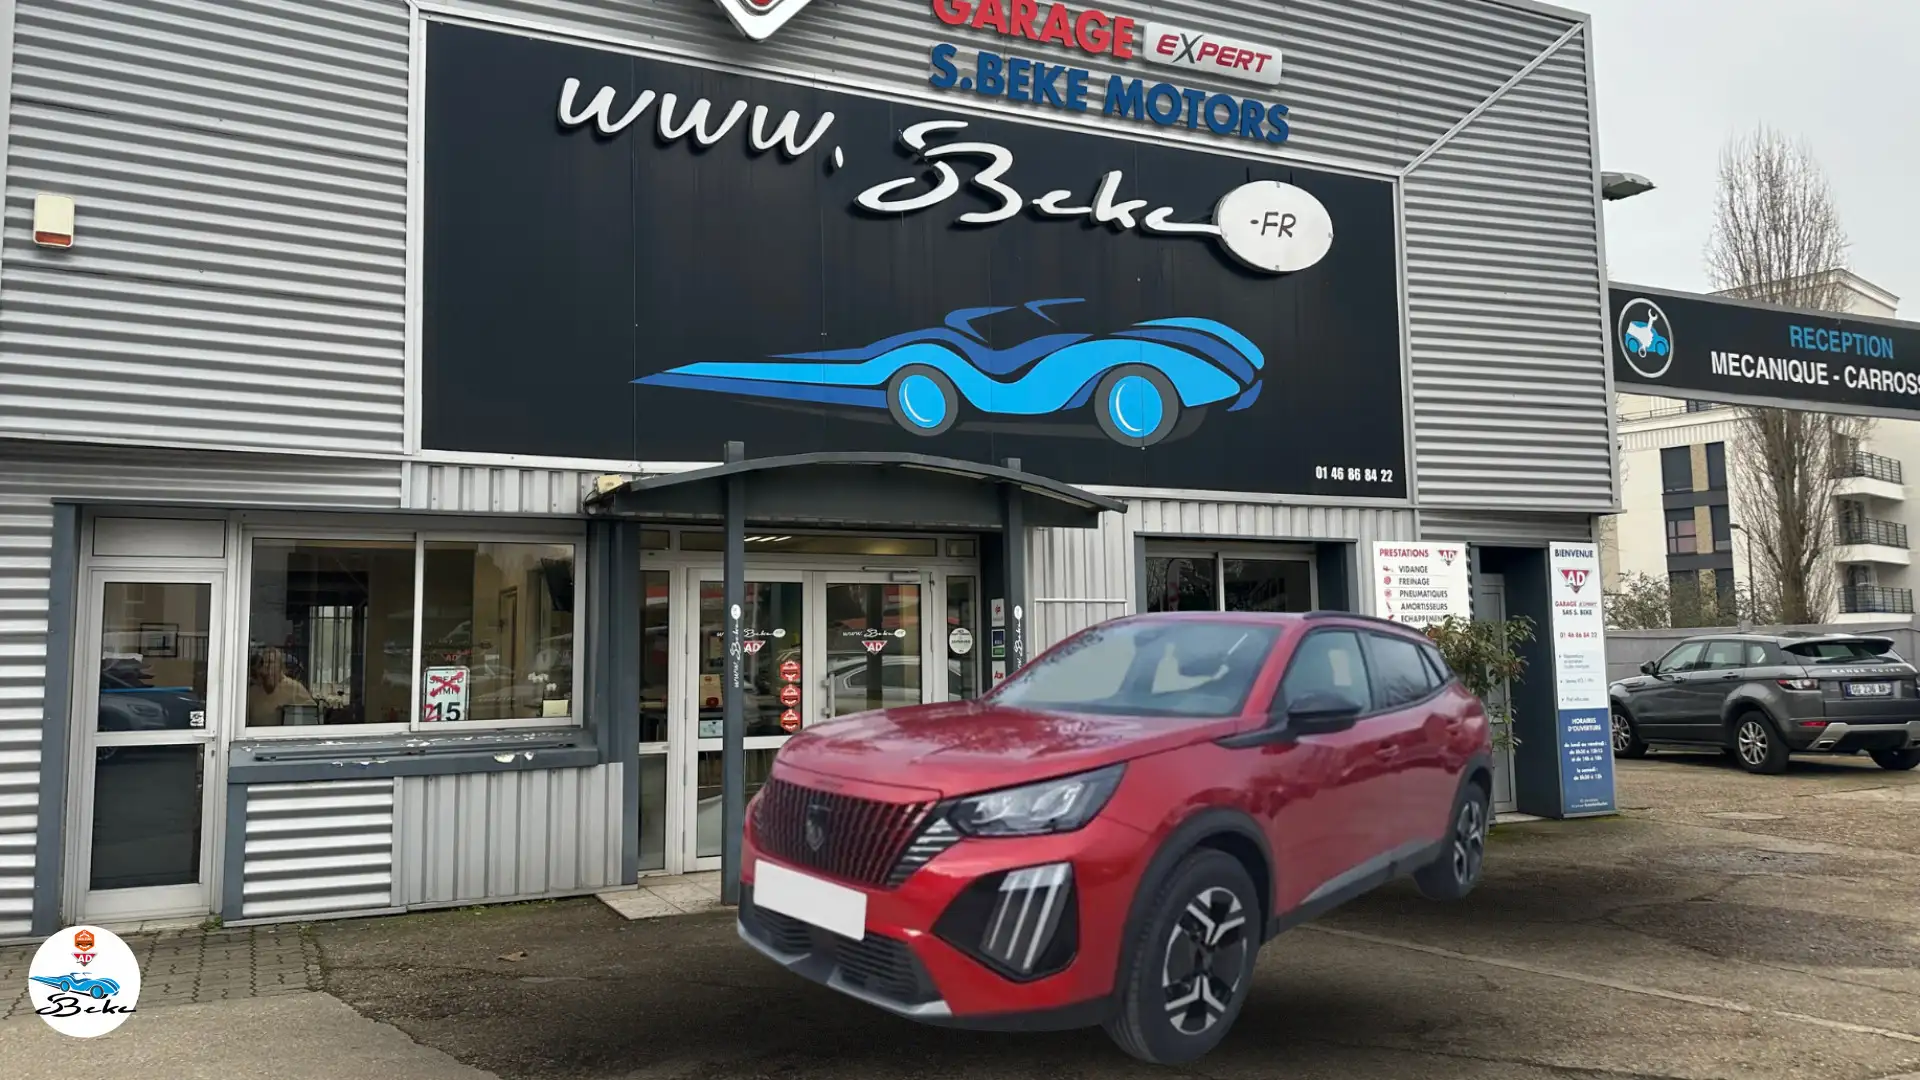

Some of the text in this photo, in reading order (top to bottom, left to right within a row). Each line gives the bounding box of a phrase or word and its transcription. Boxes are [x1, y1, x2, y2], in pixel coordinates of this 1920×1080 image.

[933, 0, 1135, 59] GARAGE
[928, 43, 1290, 144] S.BEKE MOTORS
[1788, 325, 1894, 359] RECEPTION
[1710, 350, 1830, 386] MECANIQUE
[1844, 365, 1920, 395] CARROS
[1315, 465, 1393, 483] 01 46 86 84 22
[1380, 548, 1429, 558] PRESTATIONS
[1555, 549, 1593, 558] BIENVENUE
[1398, 565, 1428, 573] VIDANGE
[1399, 577, 1430, 586] FREINAGE
[1566, 570, 1586, 586] AD
[1400, 590, 1448, 598] PNEUMATIQUES
[1401, 602, 1448, 610] AMORTISSEURS
[1401, 614, 1445, 623] ECHAPPEMEN
[429, 675, 464, 684] SEED
[434, 702, 461, 721] 15
